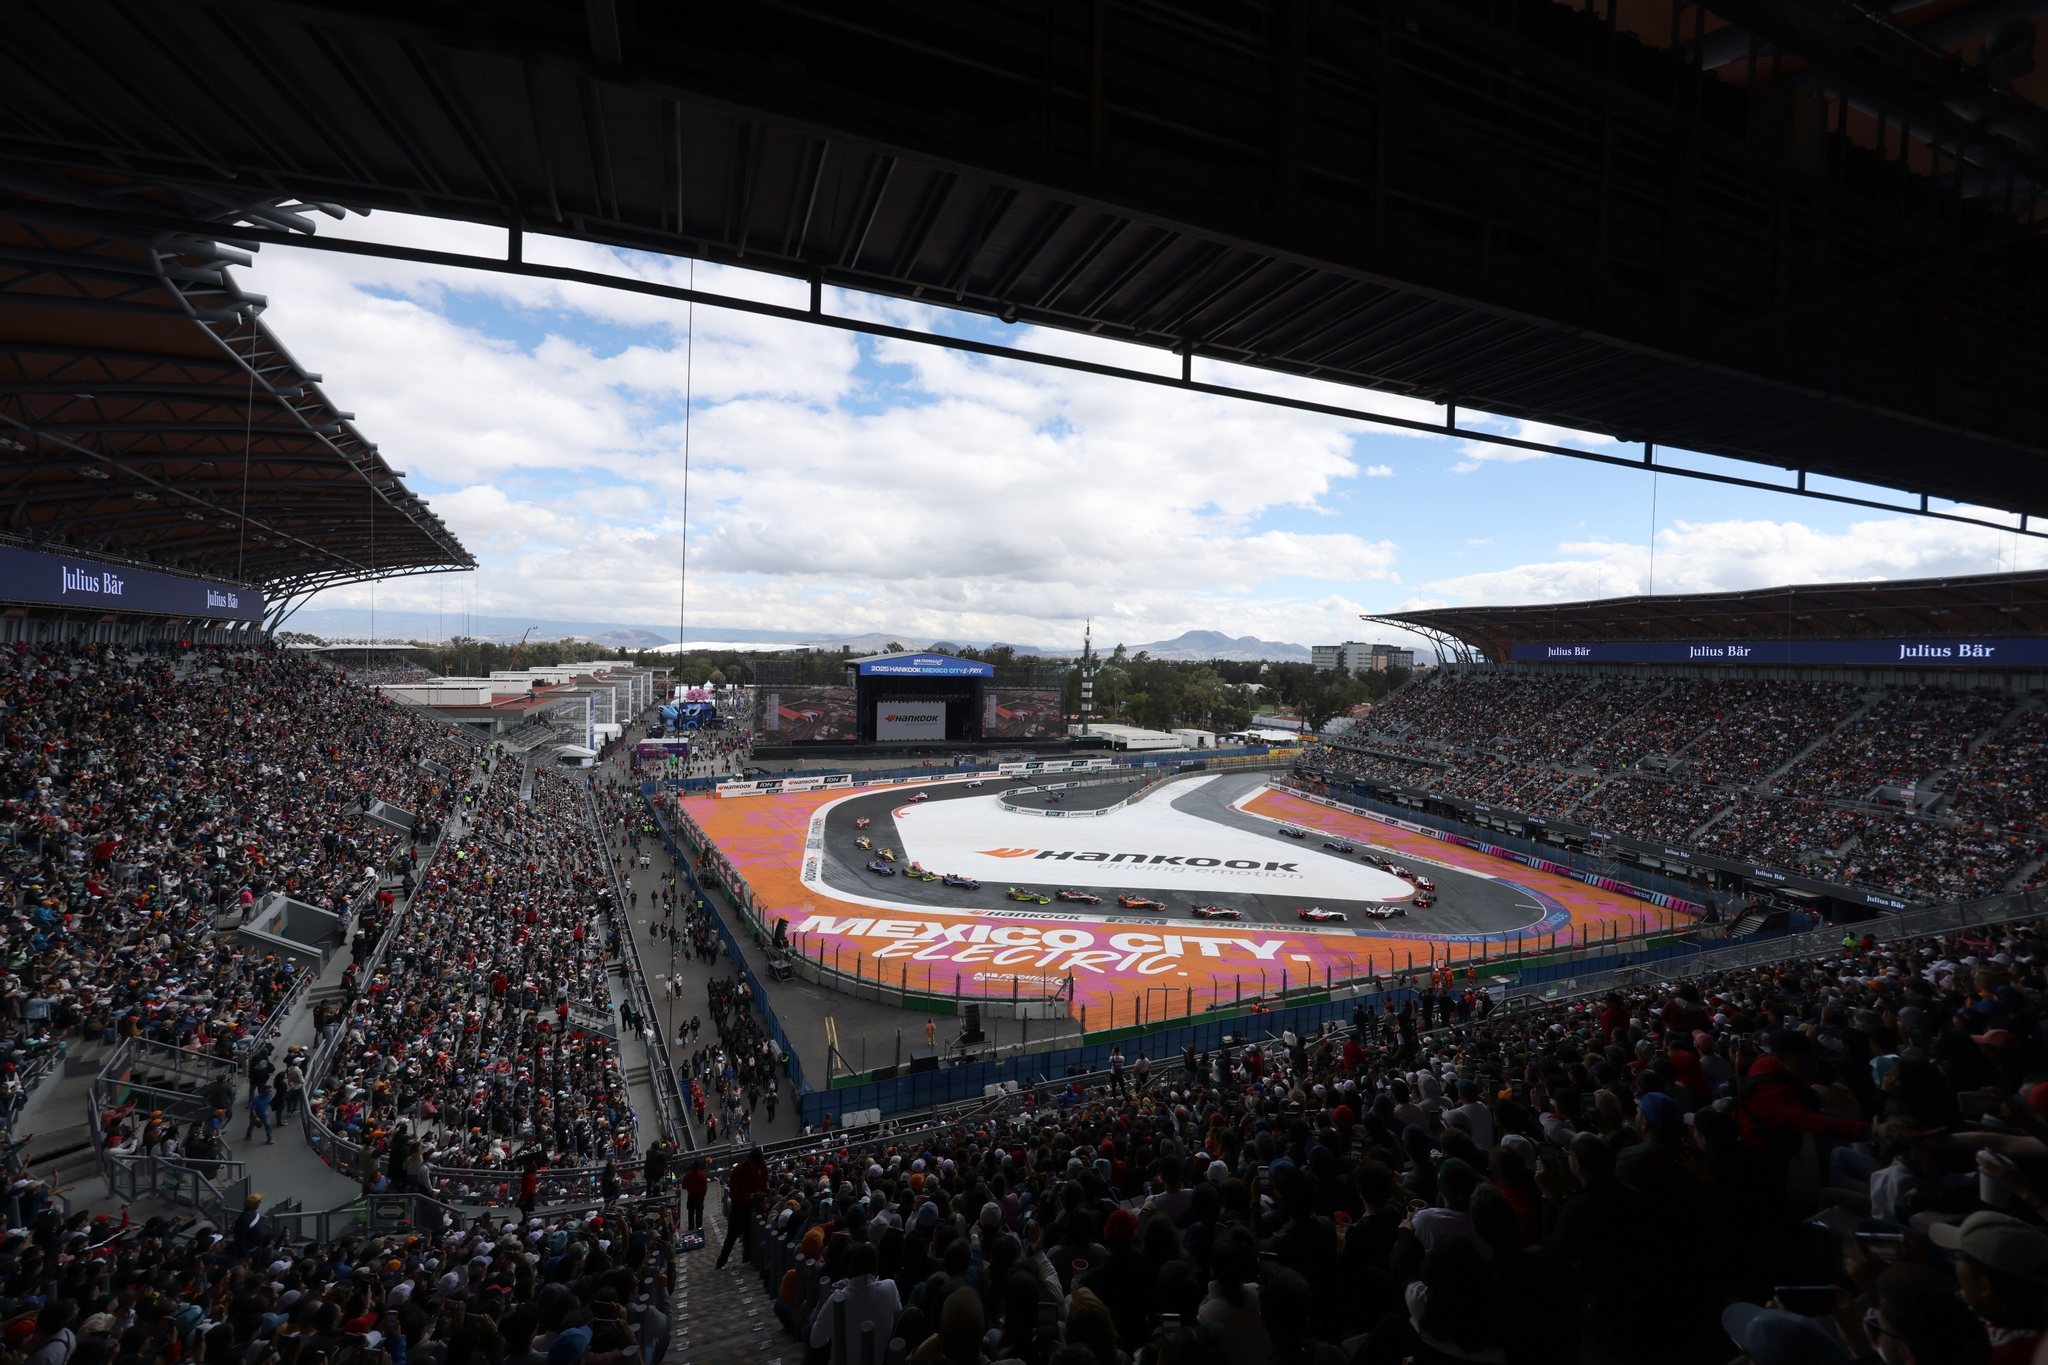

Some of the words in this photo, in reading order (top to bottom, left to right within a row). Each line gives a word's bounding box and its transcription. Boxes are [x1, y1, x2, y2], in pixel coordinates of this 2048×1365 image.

[62, 565, 100, 594] Julius
[102, 572, 124, 595] Bär
[206, 589, 227, 609] Julius
[1548, 646, 1572, 658] Julius
[1574, 646, 1591, 656] Bär
[1690, 646, 1724, 658] Julius
[1728, 646, 1751, 656] Bär
[1899, 644, 1952, 660] Julius
[1958, 644, 1995, 658] Bär
[1096, 863, 1186, 874] driving
[1196, 868, 1304, 880] emotion
[1755, 869, 1772, 878] Julius
[1774, 872, 1786, 881] Bär
[1866, 894, 1888, 906] Julius
[1890, 900, 1906, 910] Bär
[794, 915, 1095, 951] MEXICO
